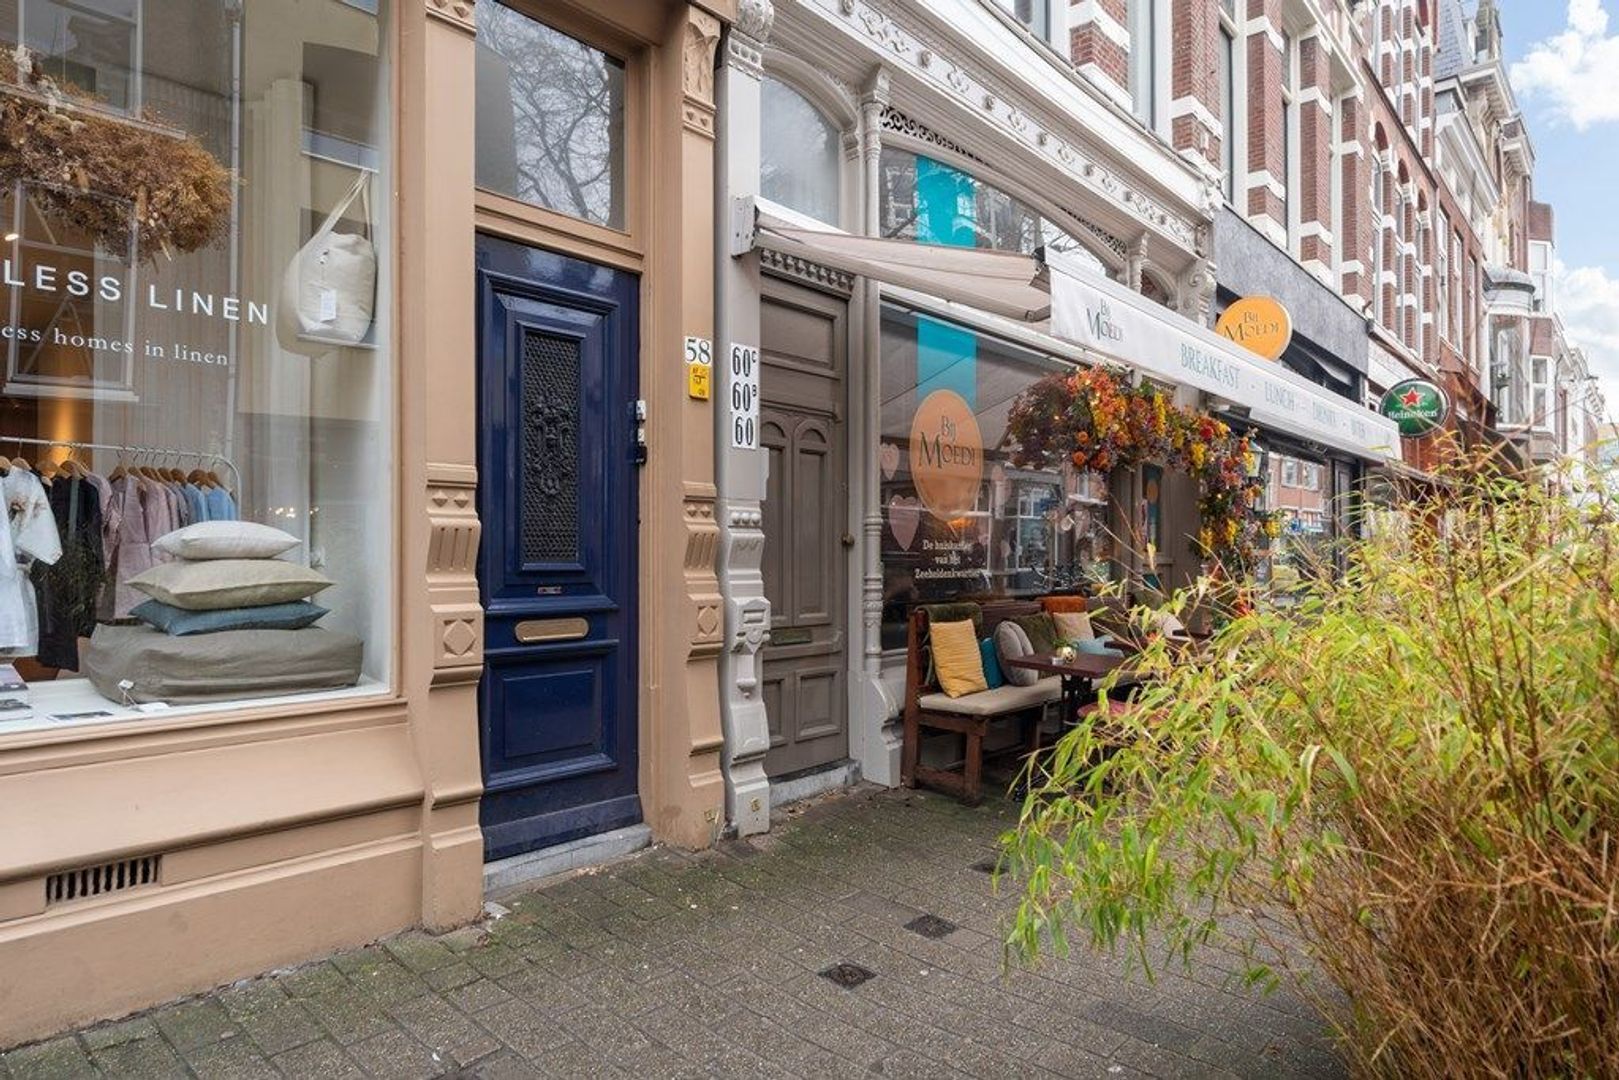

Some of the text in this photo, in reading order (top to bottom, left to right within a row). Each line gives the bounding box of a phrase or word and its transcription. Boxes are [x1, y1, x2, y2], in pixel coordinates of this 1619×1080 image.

[3, 259, 269, 325] LESS LINEN
[1, 325, 229, 366] ess homes in linen
[685, 338, 711, 365] 58
[1180, 343, 1241, 389] BREAKFAST
[735, 416, 754, 446] 60
[922, 539, 933, 550] De
